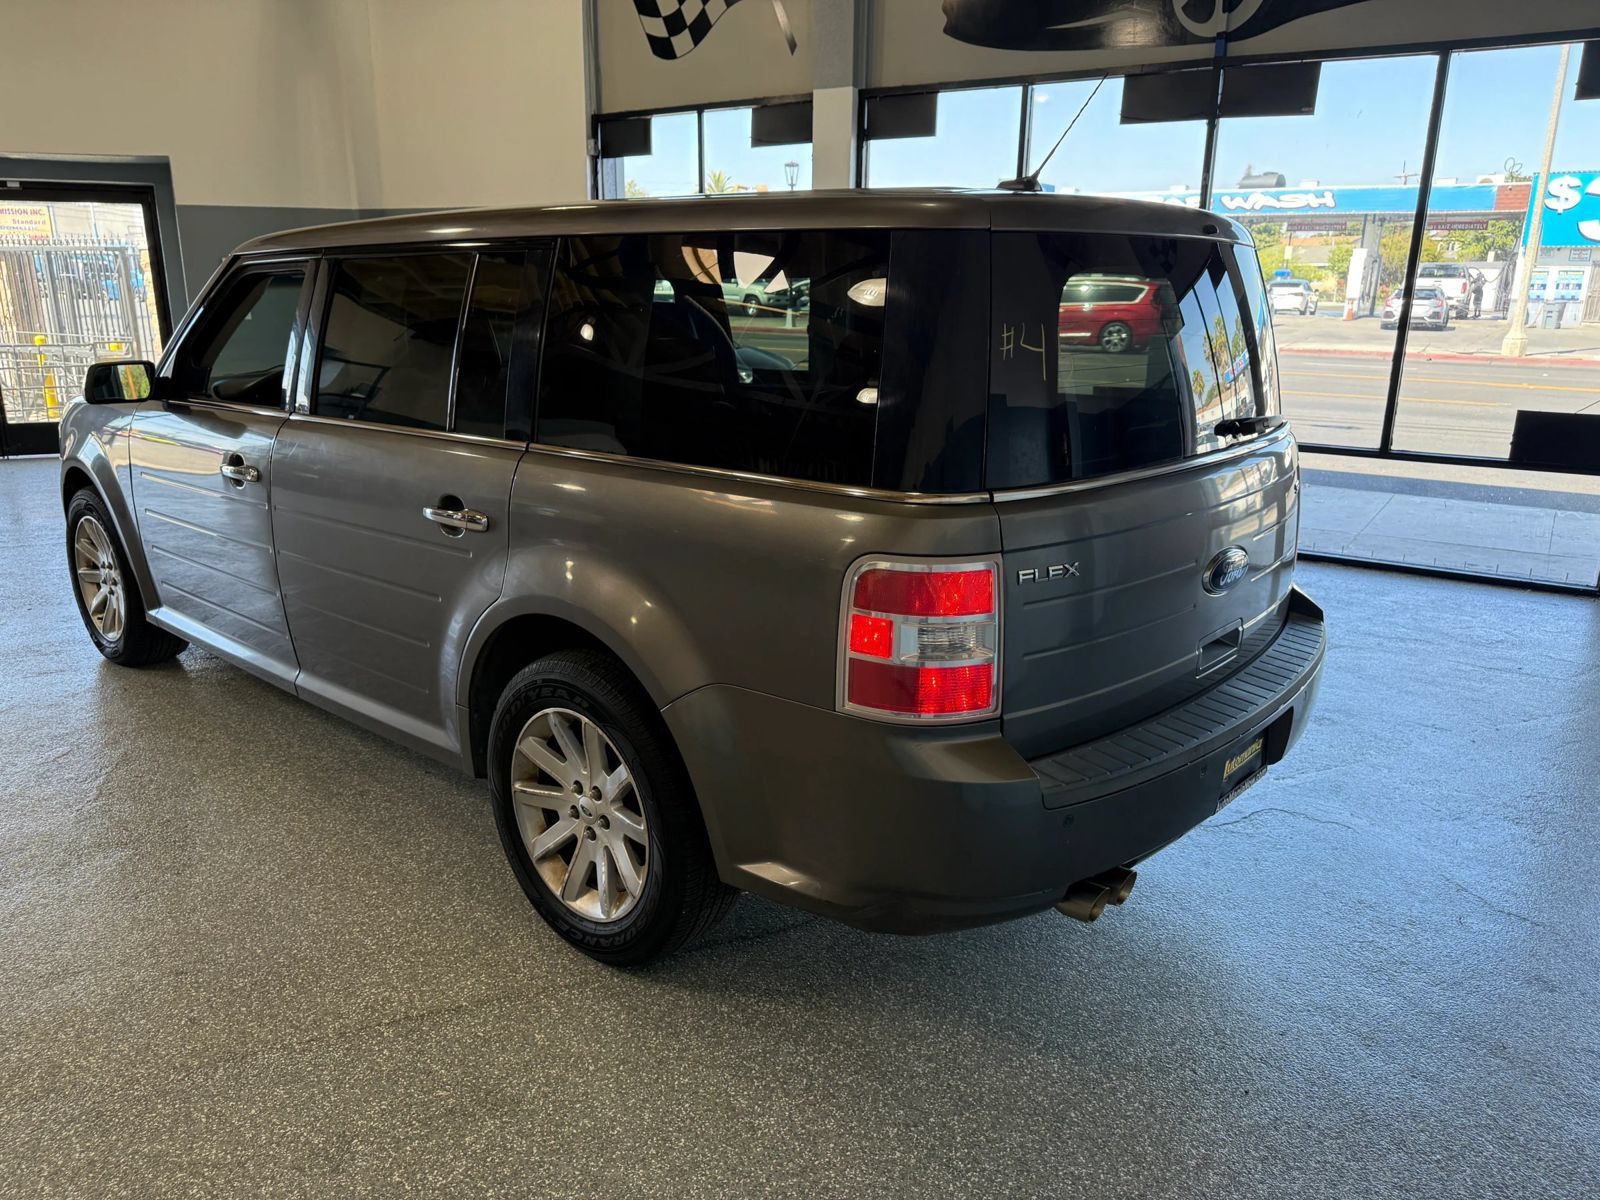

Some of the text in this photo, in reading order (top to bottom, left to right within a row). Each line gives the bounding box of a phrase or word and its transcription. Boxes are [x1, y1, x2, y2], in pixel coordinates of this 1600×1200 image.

[1221, 190, 1336, 210] WASH
[999, 322, 1048, 382] #4
[1017, 561, 1081, 586] FLEX
